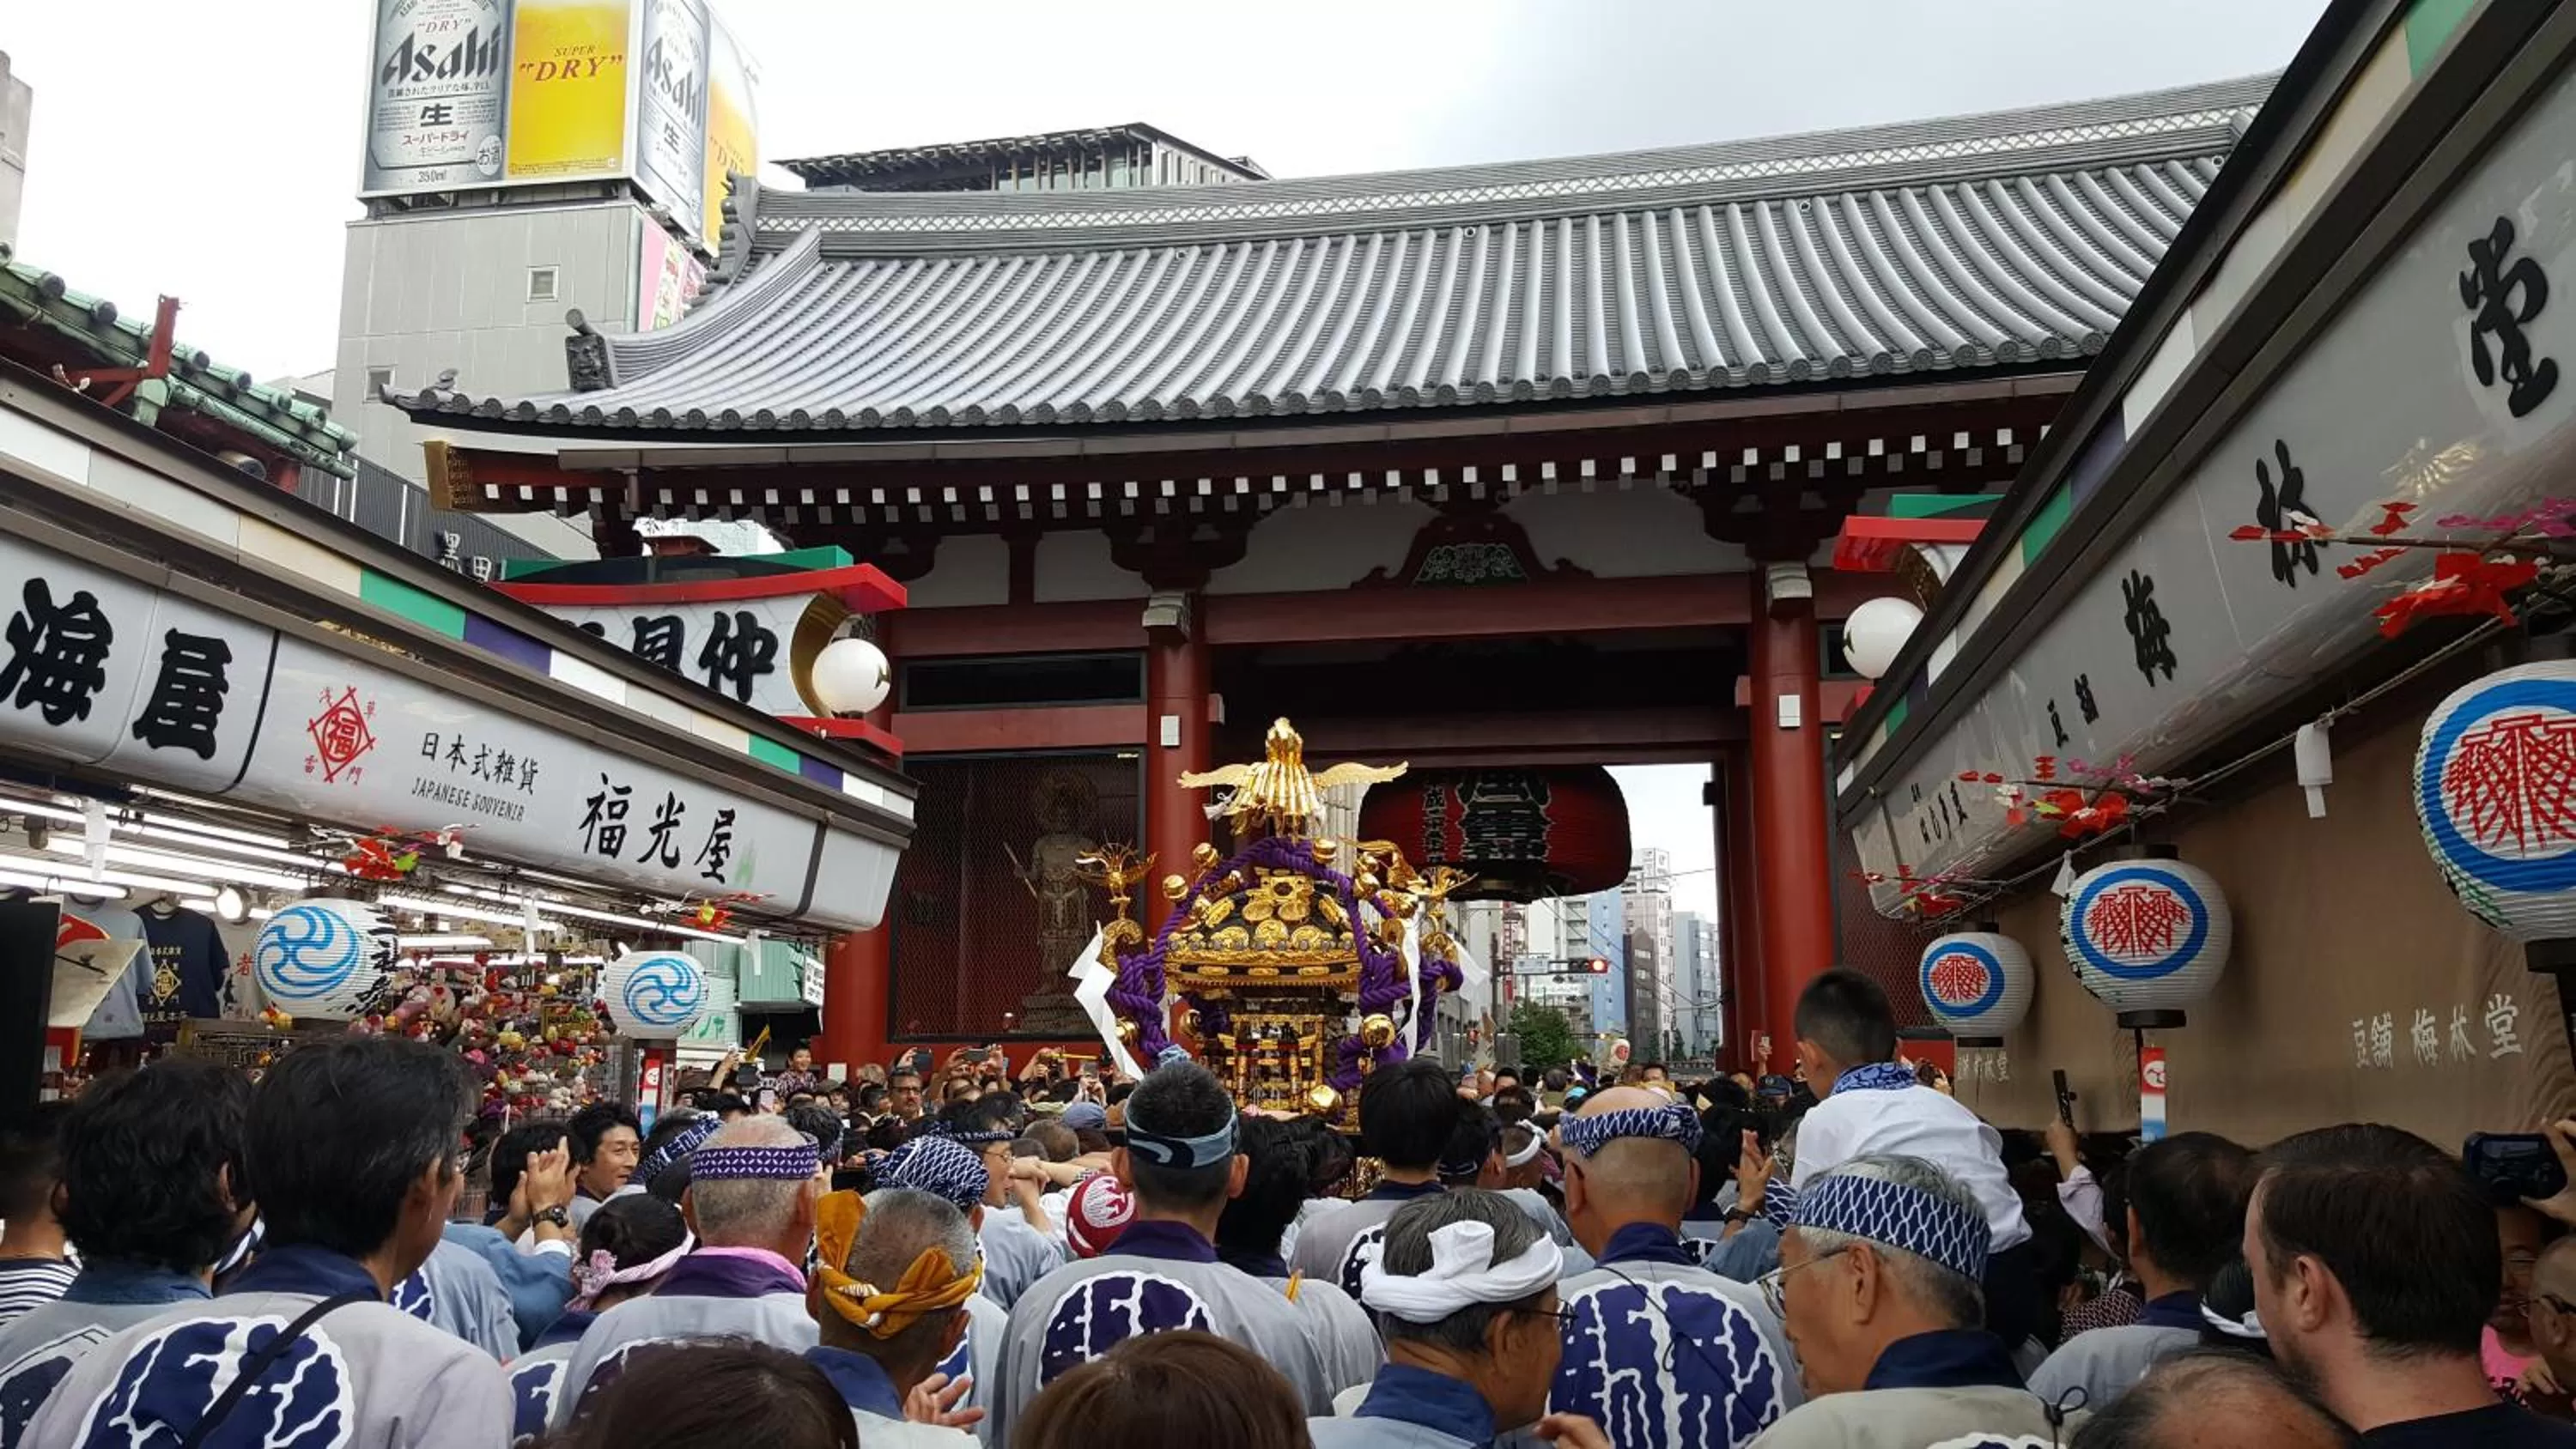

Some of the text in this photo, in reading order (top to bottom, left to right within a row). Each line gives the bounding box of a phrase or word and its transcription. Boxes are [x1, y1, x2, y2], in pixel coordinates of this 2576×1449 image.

[381, 23, 501, 85] Asahi
[555, 45, 597, 57] SUPER
[646, 36, 702, 129] Asahi
[420, 103, 453, 127] 生
[402, 130, 470, 145] スーパードライ
[477, 140, 501, 166] お酒
[664, 122, 679, 155] 生
[328, 715, 356, 755] 福
[411, 777, 526, 822] JAPANESE SOUVENIR
[579, 772, 735, 884] 福光屋
